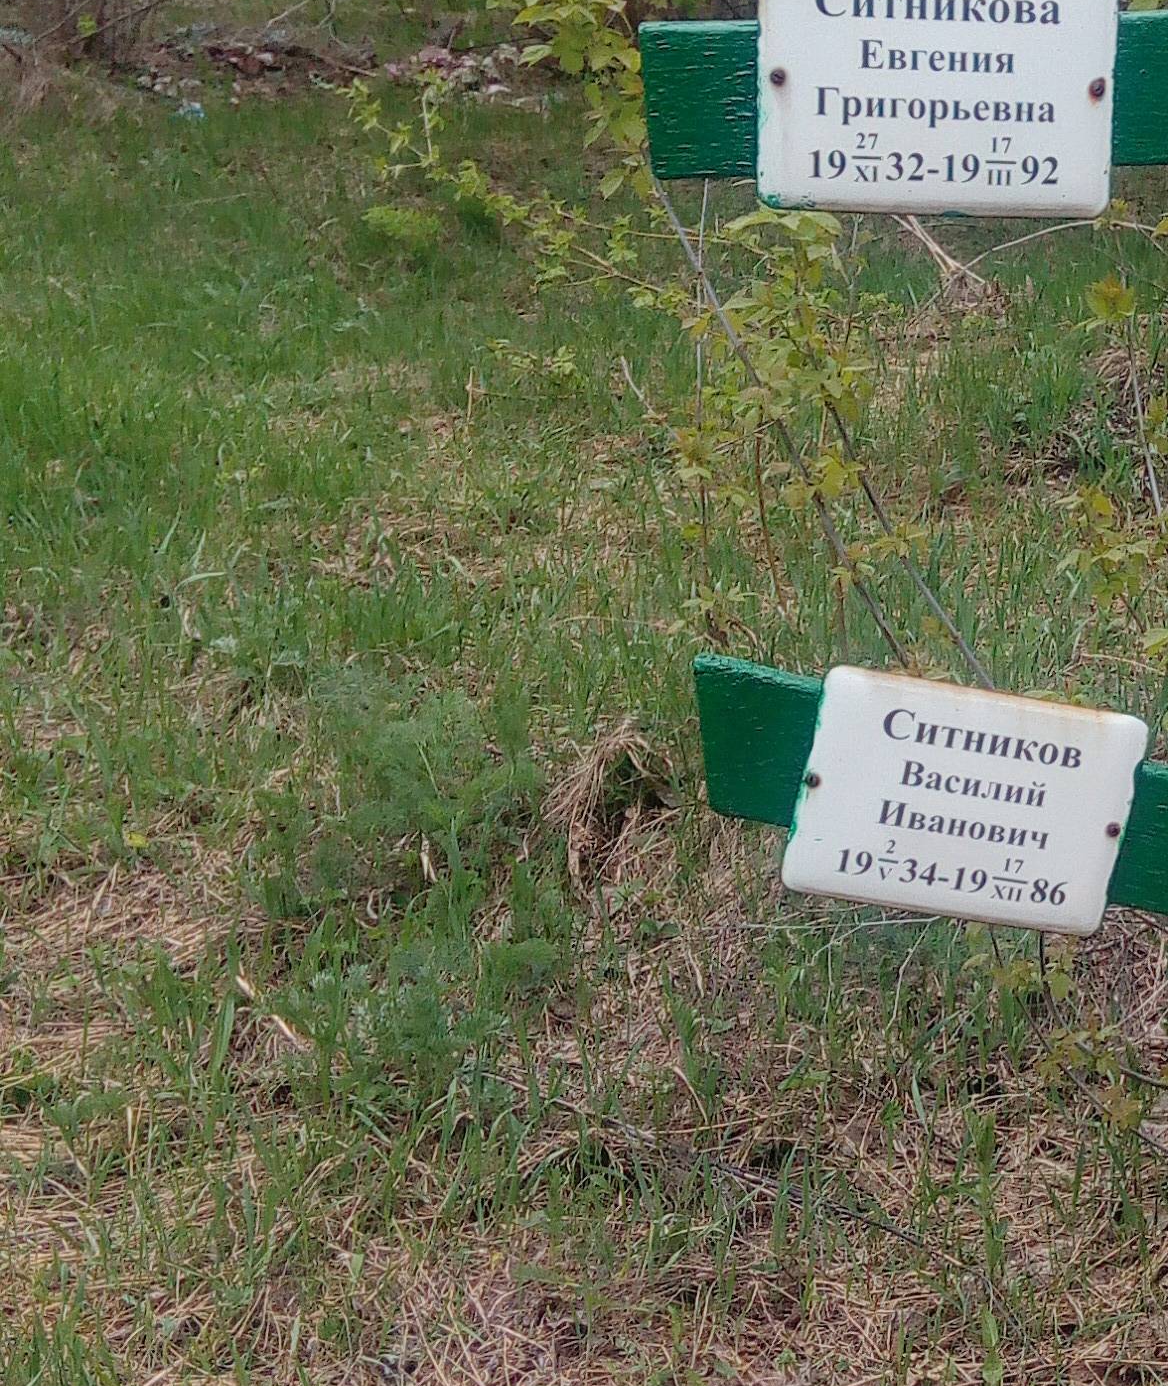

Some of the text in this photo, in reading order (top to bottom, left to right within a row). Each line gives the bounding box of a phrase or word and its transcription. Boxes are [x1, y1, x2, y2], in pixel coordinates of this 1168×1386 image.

[858, 39, 1014, 74] Евгения
[815, 86, 1055, 128] Григорьевна
[883, 708, 1082, 769] Ситников
[899, 760, 1046, 807] Василий
[876, 799, 1049, 851] Иванович
